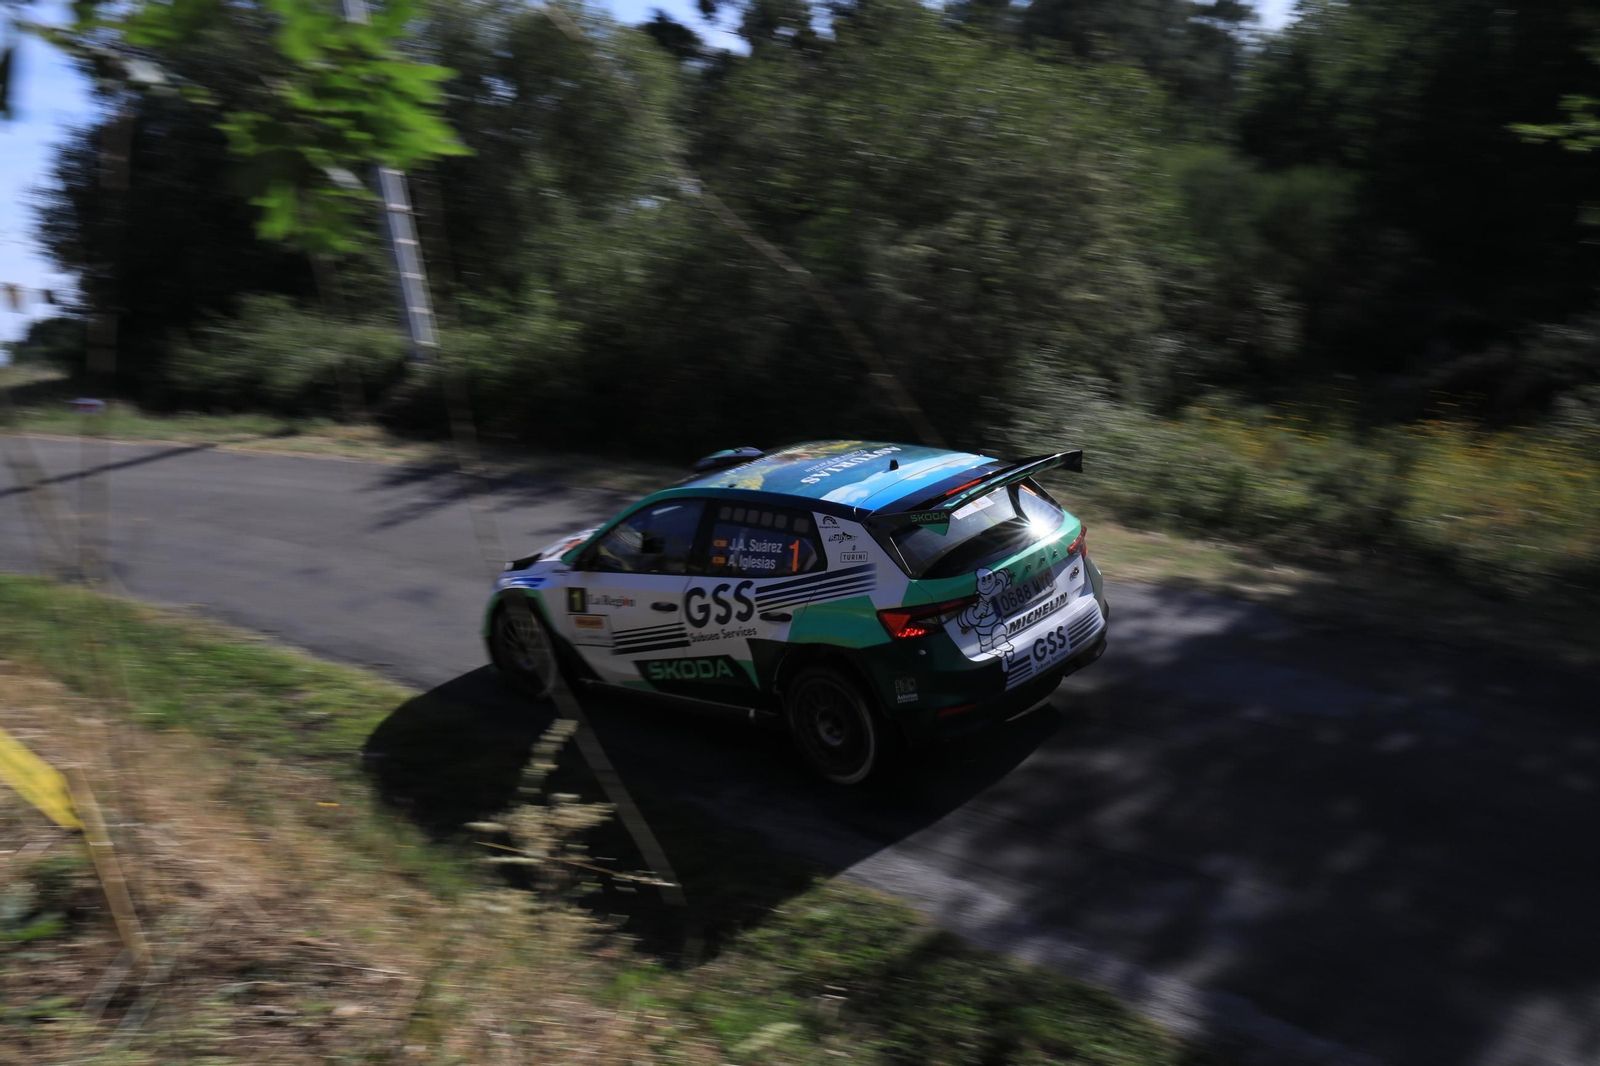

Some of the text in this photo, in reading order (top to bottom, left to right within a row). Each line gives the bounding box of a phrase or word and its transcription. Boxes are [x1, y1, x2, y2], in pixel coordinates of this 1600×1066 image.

[749, 539, 783, 553] Suárez
[789, 540, 800, 572] 1
[727, 555, 776, 570] A. Iglesias
[842, 554, 866, 562] TURINI
[685, 580, 755, 628] GSS
[1002, 585, 1032, 611] 0688
[1009, 592, 1068, 634] MICHELIN
[690, 627, 757, 643] Subsea Services
[1033, 625, 1067, 662] GSS
[650, 659, 734, 680] SKODA
